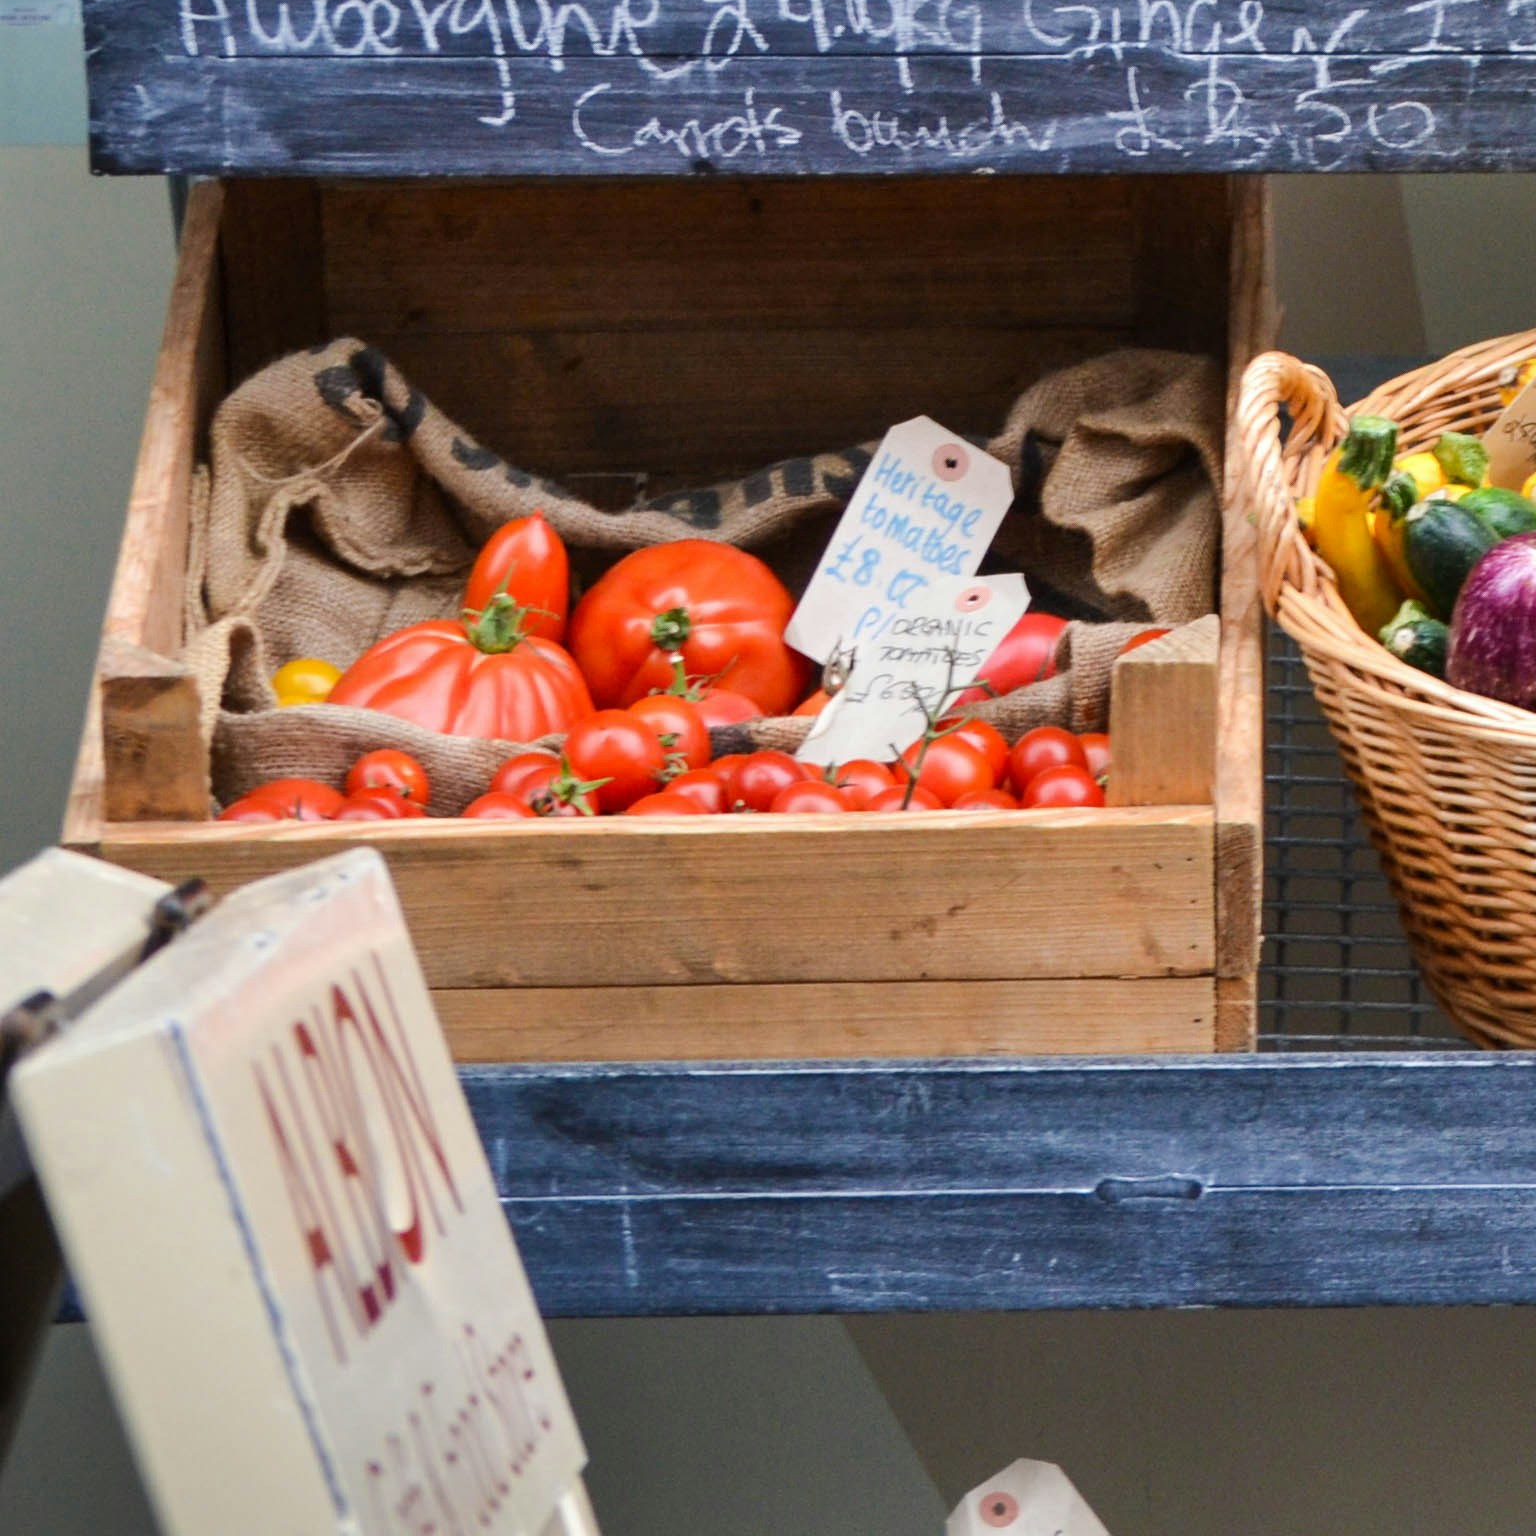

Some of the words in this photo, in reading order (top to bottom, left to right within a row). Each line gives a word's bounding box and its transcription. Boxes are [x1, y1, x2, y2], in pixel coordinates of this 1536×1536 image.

[571, 80, 803, 157] Carrots
[860, 492, 972, 576] tomatoes
[872, 451, 985, 539] Heritage
[891, 617, 993, 638] ORGANIC
